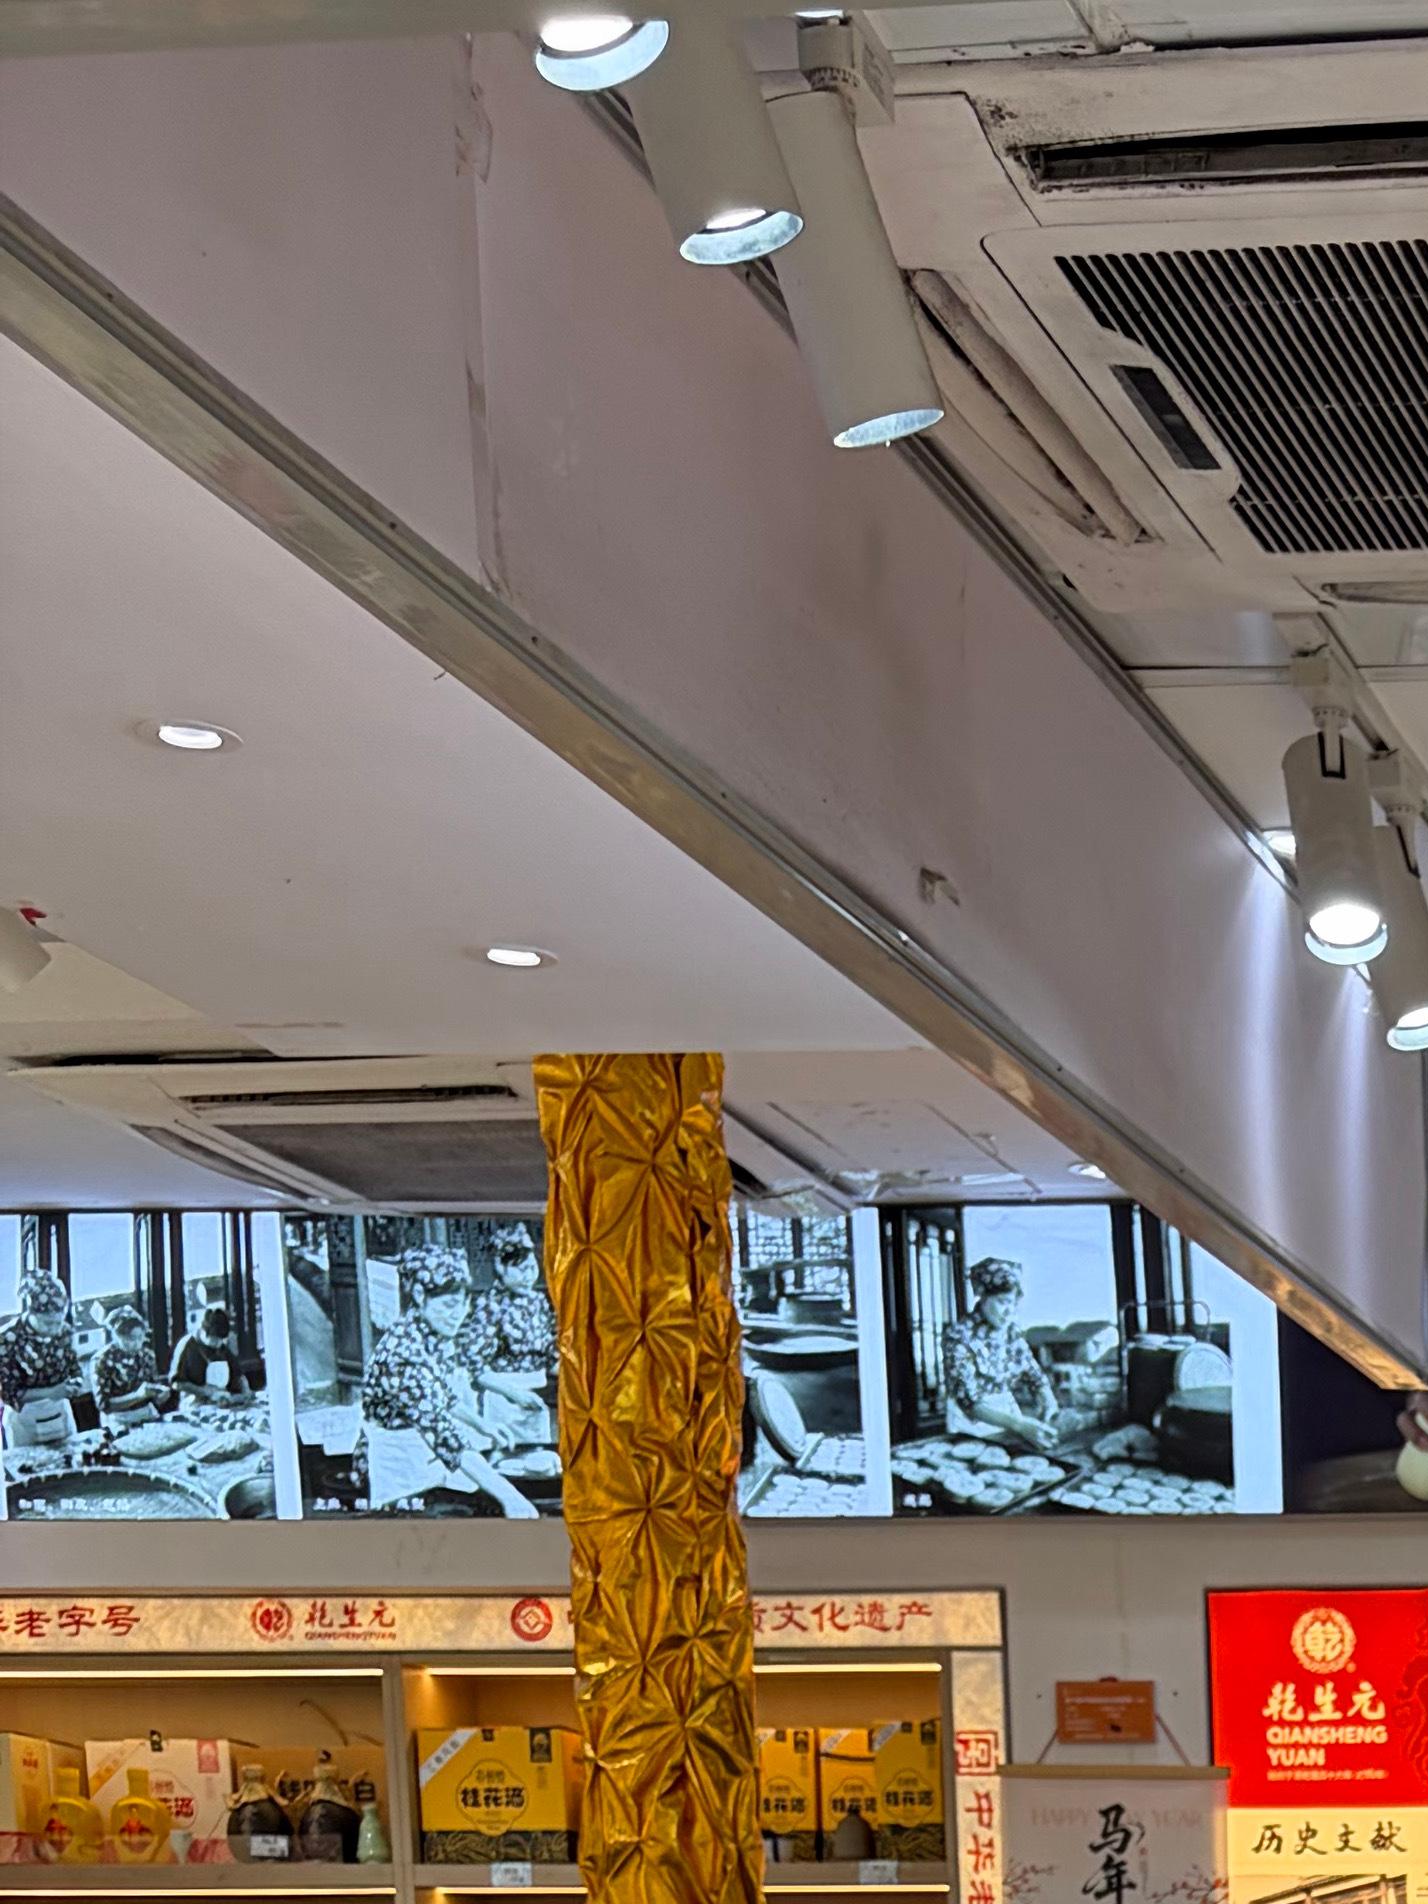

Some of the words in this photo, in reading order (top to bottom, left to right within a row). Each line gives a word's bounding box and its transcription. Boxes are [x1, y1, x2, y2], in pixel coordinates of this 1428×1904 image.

[0, 1604, 141, 1638] 老字号
[1262, 1681, 1386, 1722] 乾生元
[1266, 1726, 1388, 1745] QIANSHENG
[1266, 1748, 1326, 1767] YUAN
[1251, 1821, 1409, 1856] 历史文献
